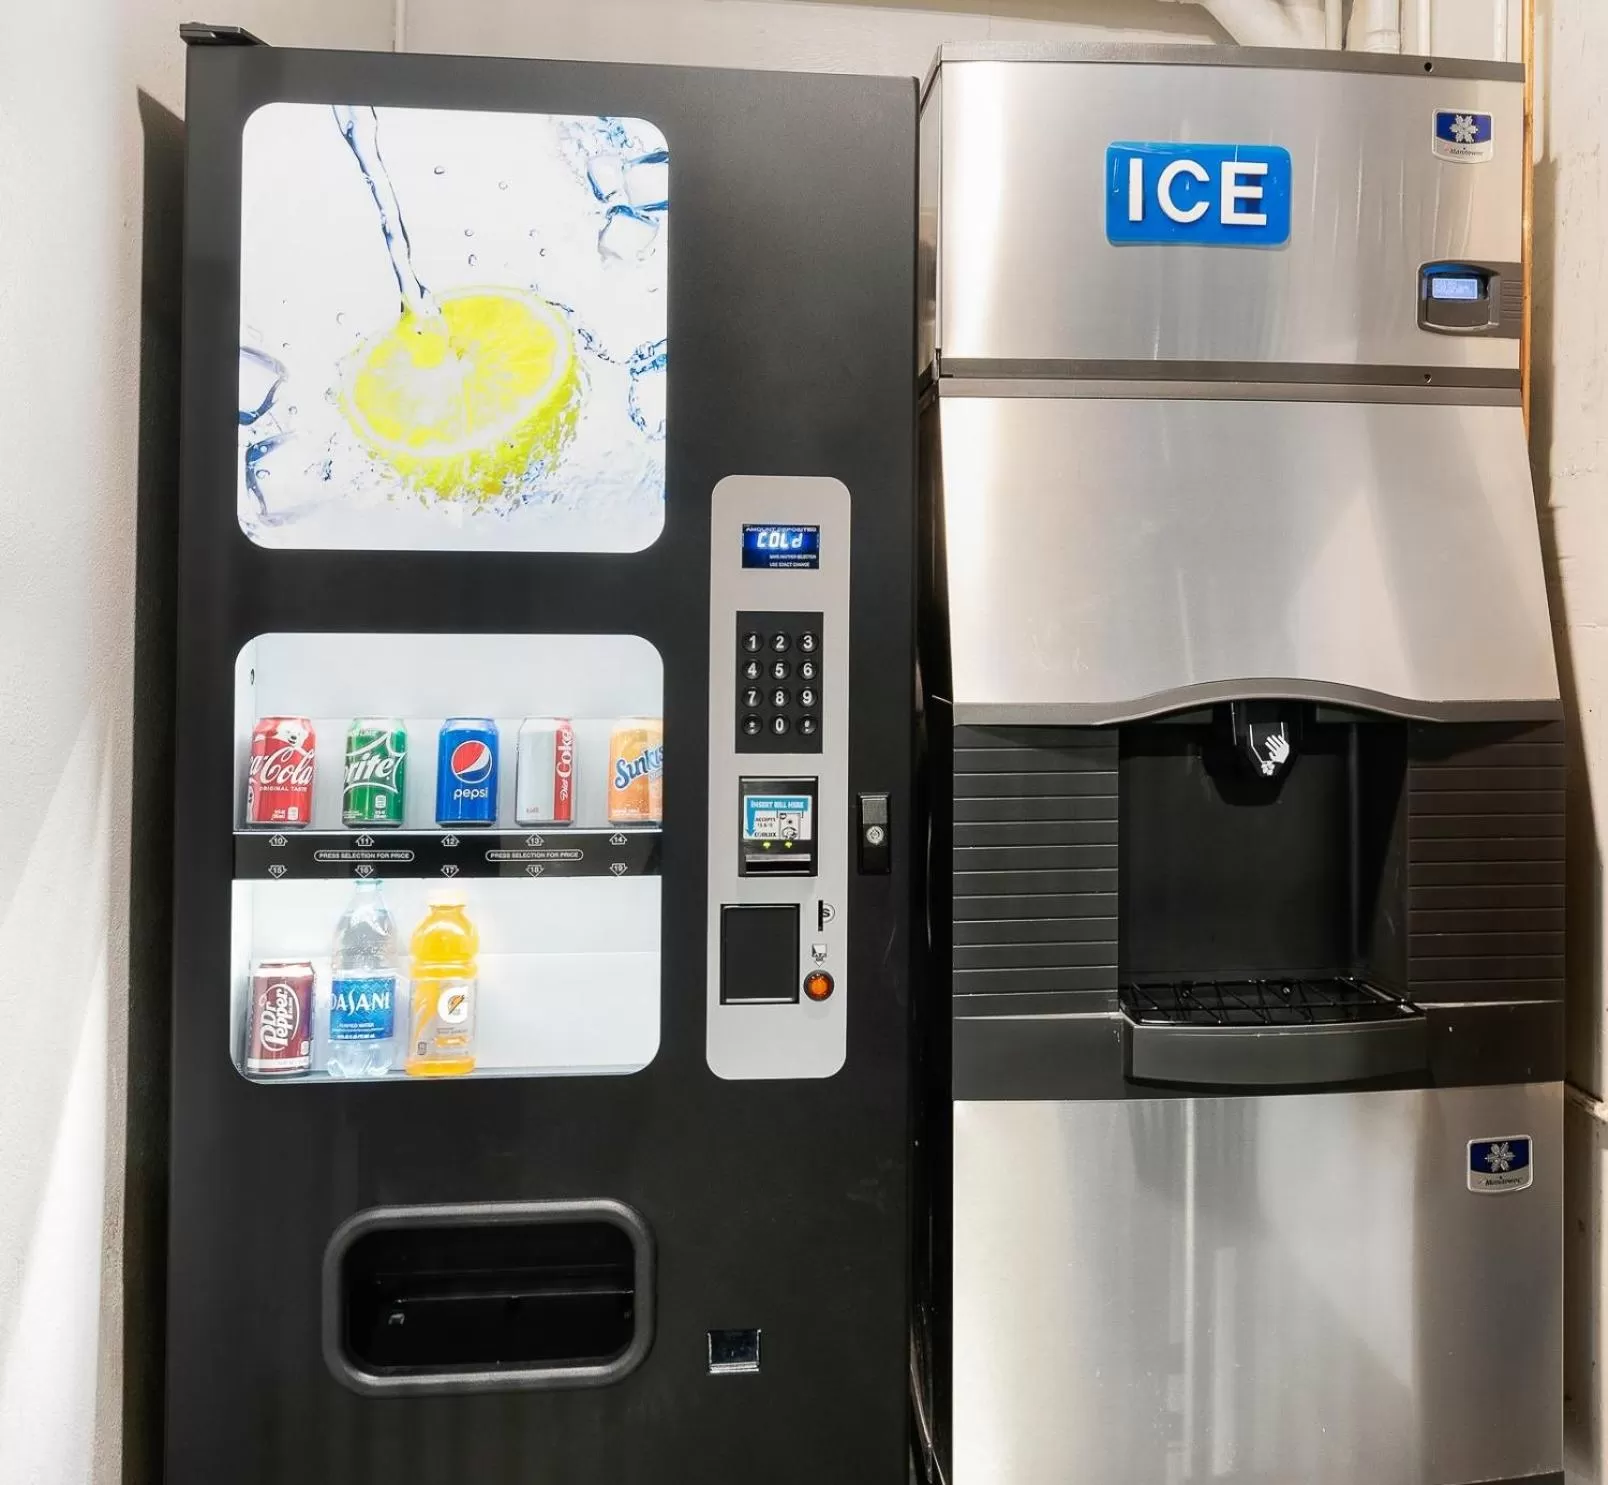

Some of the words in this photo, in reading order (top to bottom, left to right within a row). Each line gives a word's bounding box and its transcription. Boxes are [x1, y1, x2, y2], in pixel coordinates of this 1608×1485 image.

[1128, 158, 1268, 225] ICE
[749, 635, 756, 649] 1
[776, 635, 784, 649] 2
[803, 635, 813, 649] 3
[748, 662, 757, 676] 4
[775, 663, 784, 677] 5
[803, 662, 813, 676] 6
[748, 690, 756, 704] 7
[775, 691, 784, 704] 8
[802, 690, 812, 704] 9
[775, 718, 784, 732] 0
[344, 752, 395, 783] rite
[453, 787, 488, 800] pepsi
[330, 988, 391, 1016] DASANI
[261, 1001, 277, 1026] Dr
[261, 987, 293, 1047] Pepper
